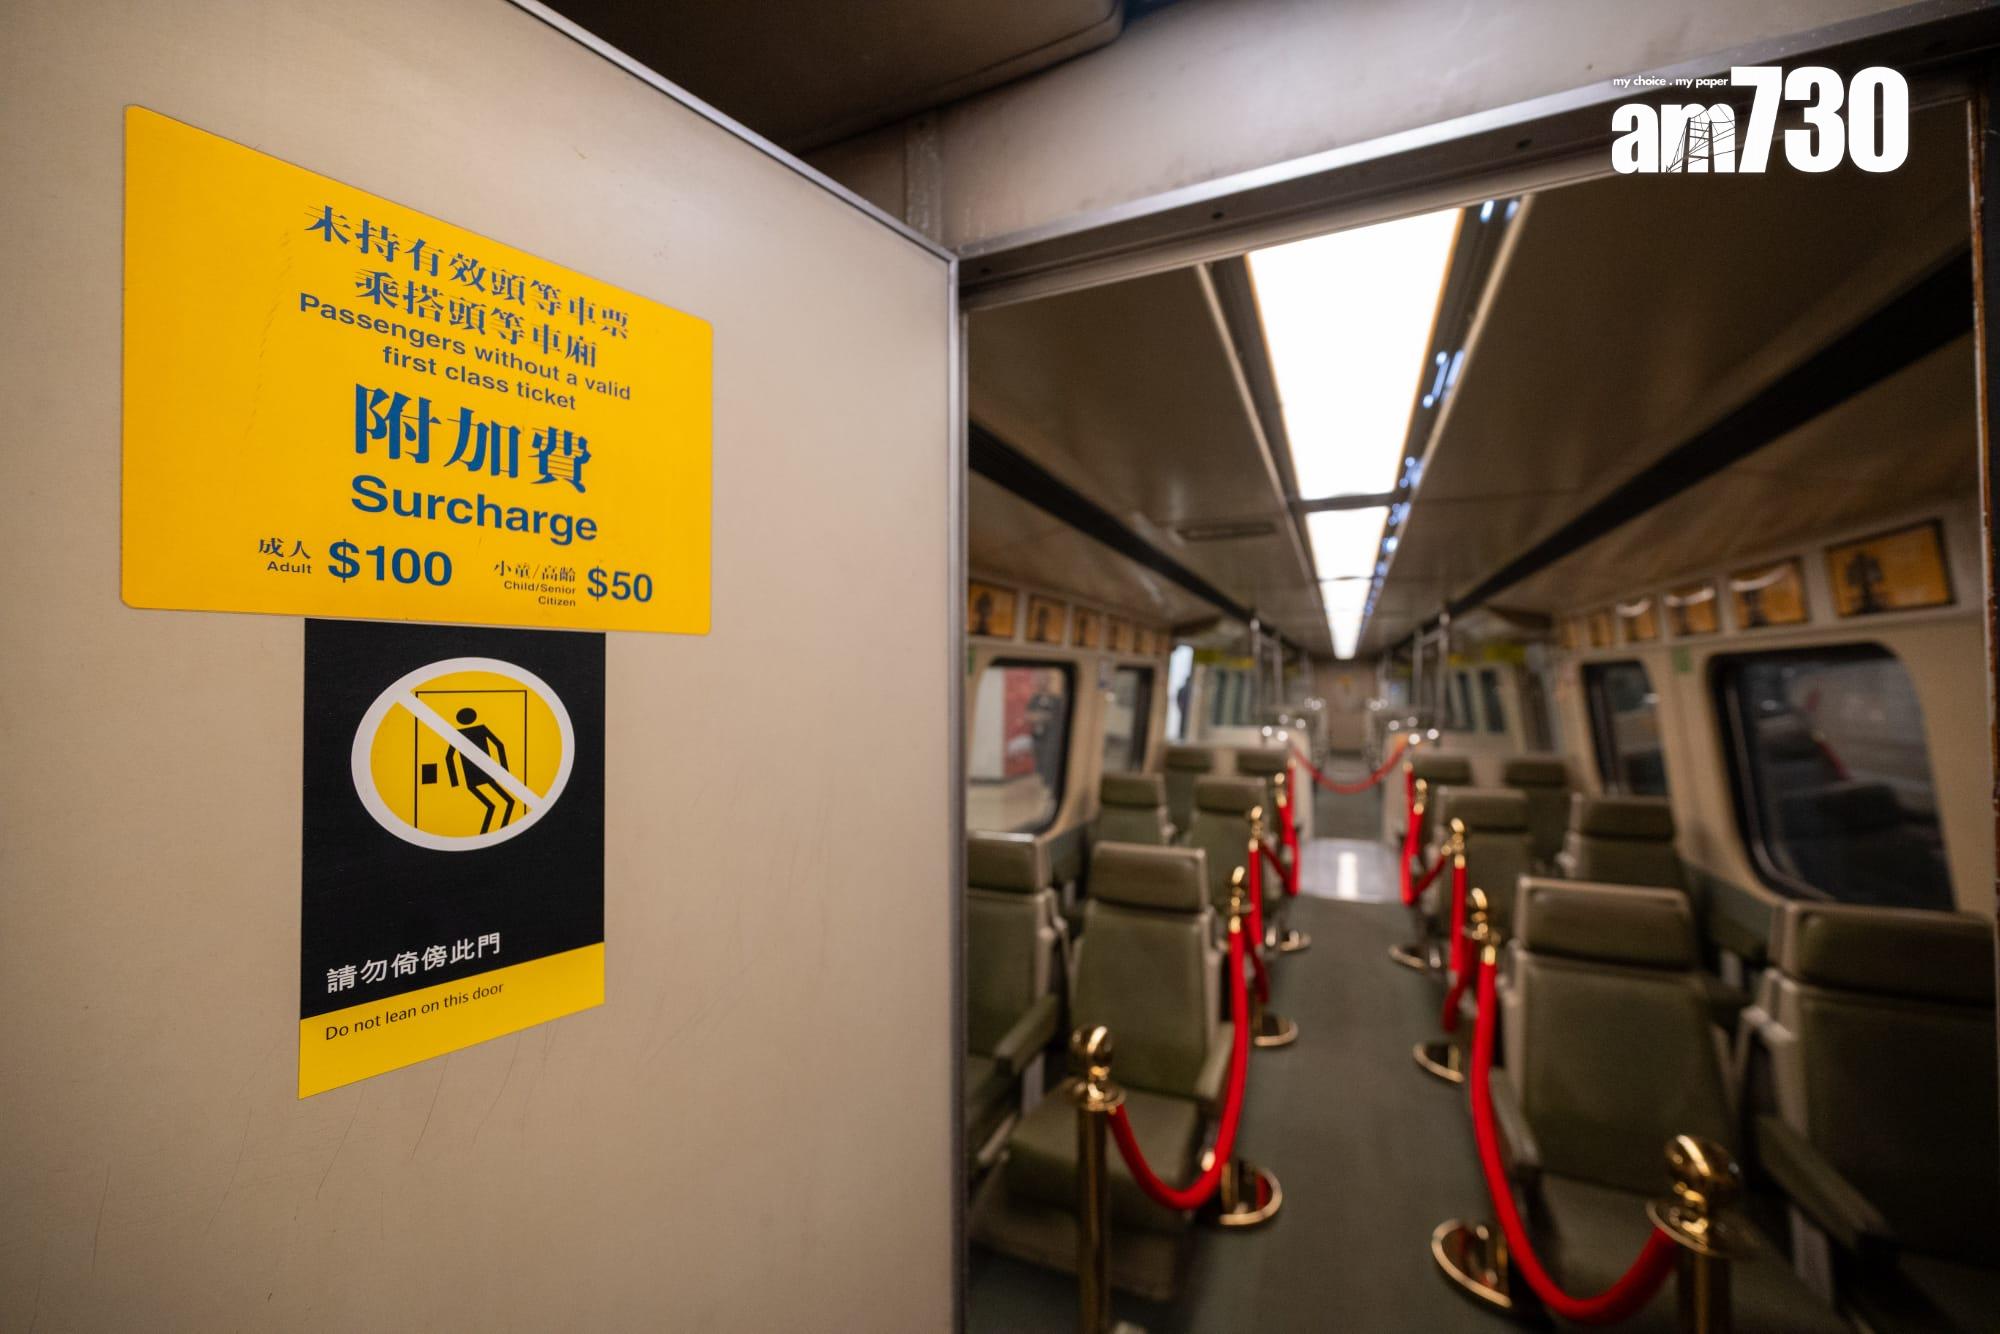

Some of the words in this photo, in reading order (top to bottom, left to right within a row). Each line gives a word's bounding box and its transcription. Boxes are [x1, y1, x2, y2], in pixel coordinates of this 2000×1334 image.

[303, 204, 629, 340] 未持有效頭等車票
[300, 292, 466, 355] Passengers
[474, 345, 560, 381] without
[566, 372, 578, 386] a
[585, 376, 631, 401] valid
[355, 268, 597, 368] 乘搭頭等車廂
[382, 345, 437, 376] first
[445, 365, 509, 393] class
[517, 381, 576, 411] ticket
[355, 383, 592, 493] 附加費
[351, 474, 598, 546] Surcharge
[258, 537, 312, 560] 成人
[266, 560, 312, 575] Adult
[327, 538, 453, 587] $100
[503, 580, 576, 595] Child/Senior
[538, 595, 576, 607] Citizen
[587, 565, 653, 603] $50
[326, 932, 501, 994] 請勿倚傍此門
[325, 1025, 349, 1040] Do
[354, 1015, 381, 1033] not
[385, 1007, 416, 1025] lean
[421, 1001, 439, 1014] on
[443, 992, 469, 1008] this
[472, 983, 504, 1000] door
